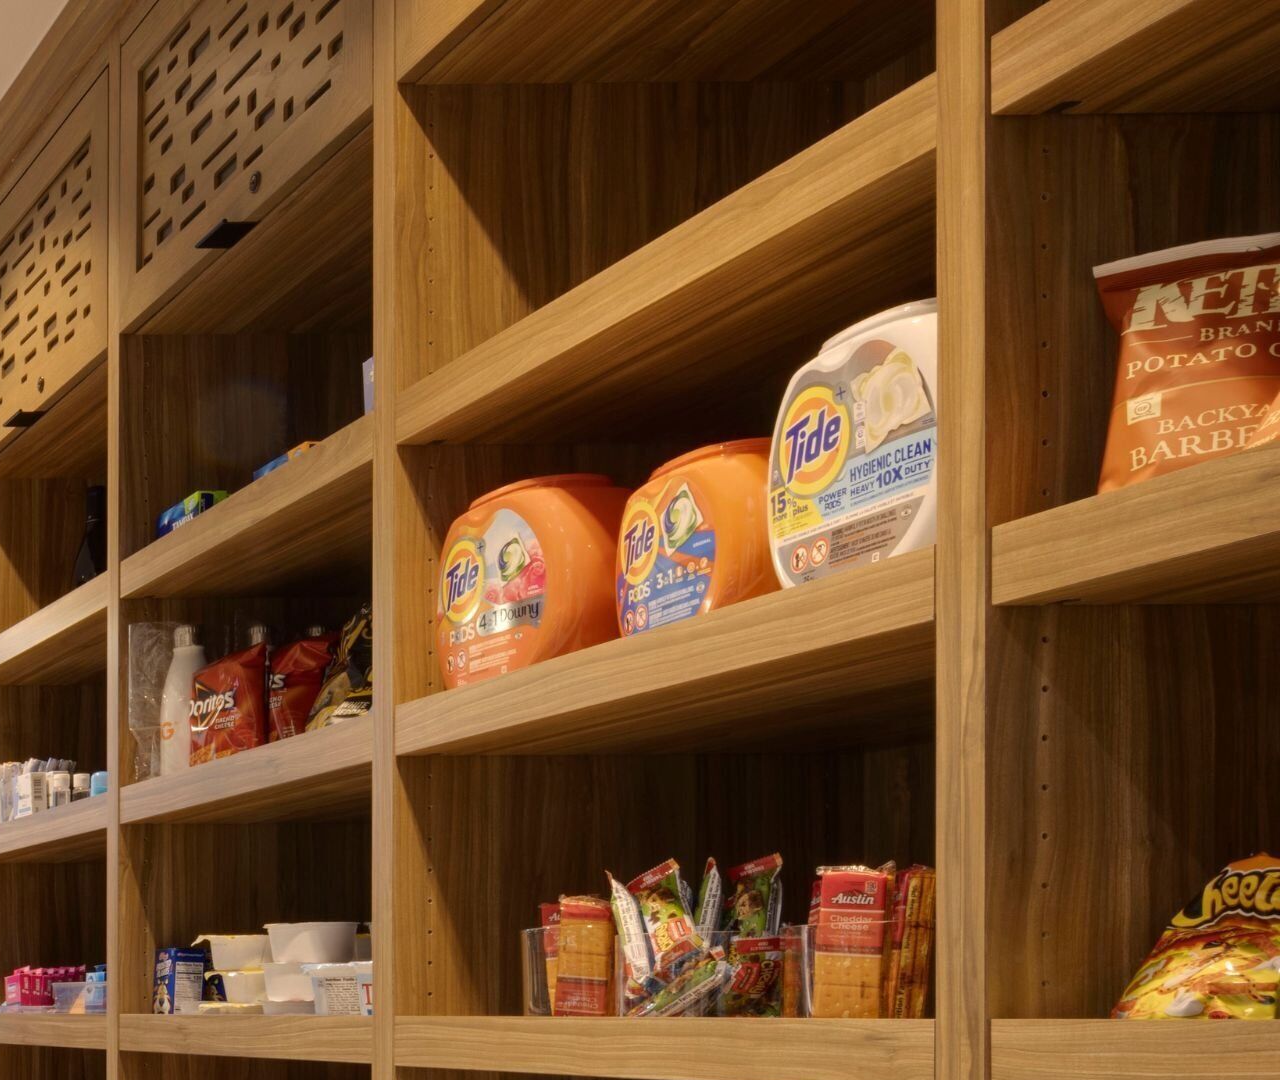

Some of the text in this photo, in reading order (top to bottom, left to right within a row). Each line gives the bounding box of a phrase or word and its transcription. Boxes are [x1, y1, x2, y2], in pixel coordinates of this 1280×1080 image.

[1125, 342, 1258, 380] POTATO
[785, 408, 842, 485] Tide
[850, 438, 932, 483] HYGIENIC CLEAN
[850, 460, 931, 497] HEAVY 10X DUTY
[818, 487, 847, 505] POWER
[824, 499, 843, 511] PODS
[792, 503, 809, 518] plus
[623, 519, 656, 580] Tide
[445, 558, 480, 612] Tide
[500, 601, 540, 624] Downy
[449, 623, 476, 647] PODS
[831, 892, 875, 906] Austin
[829, 914, 873, 923] Cheddar
[830, 921, 870, 931] Cheese
